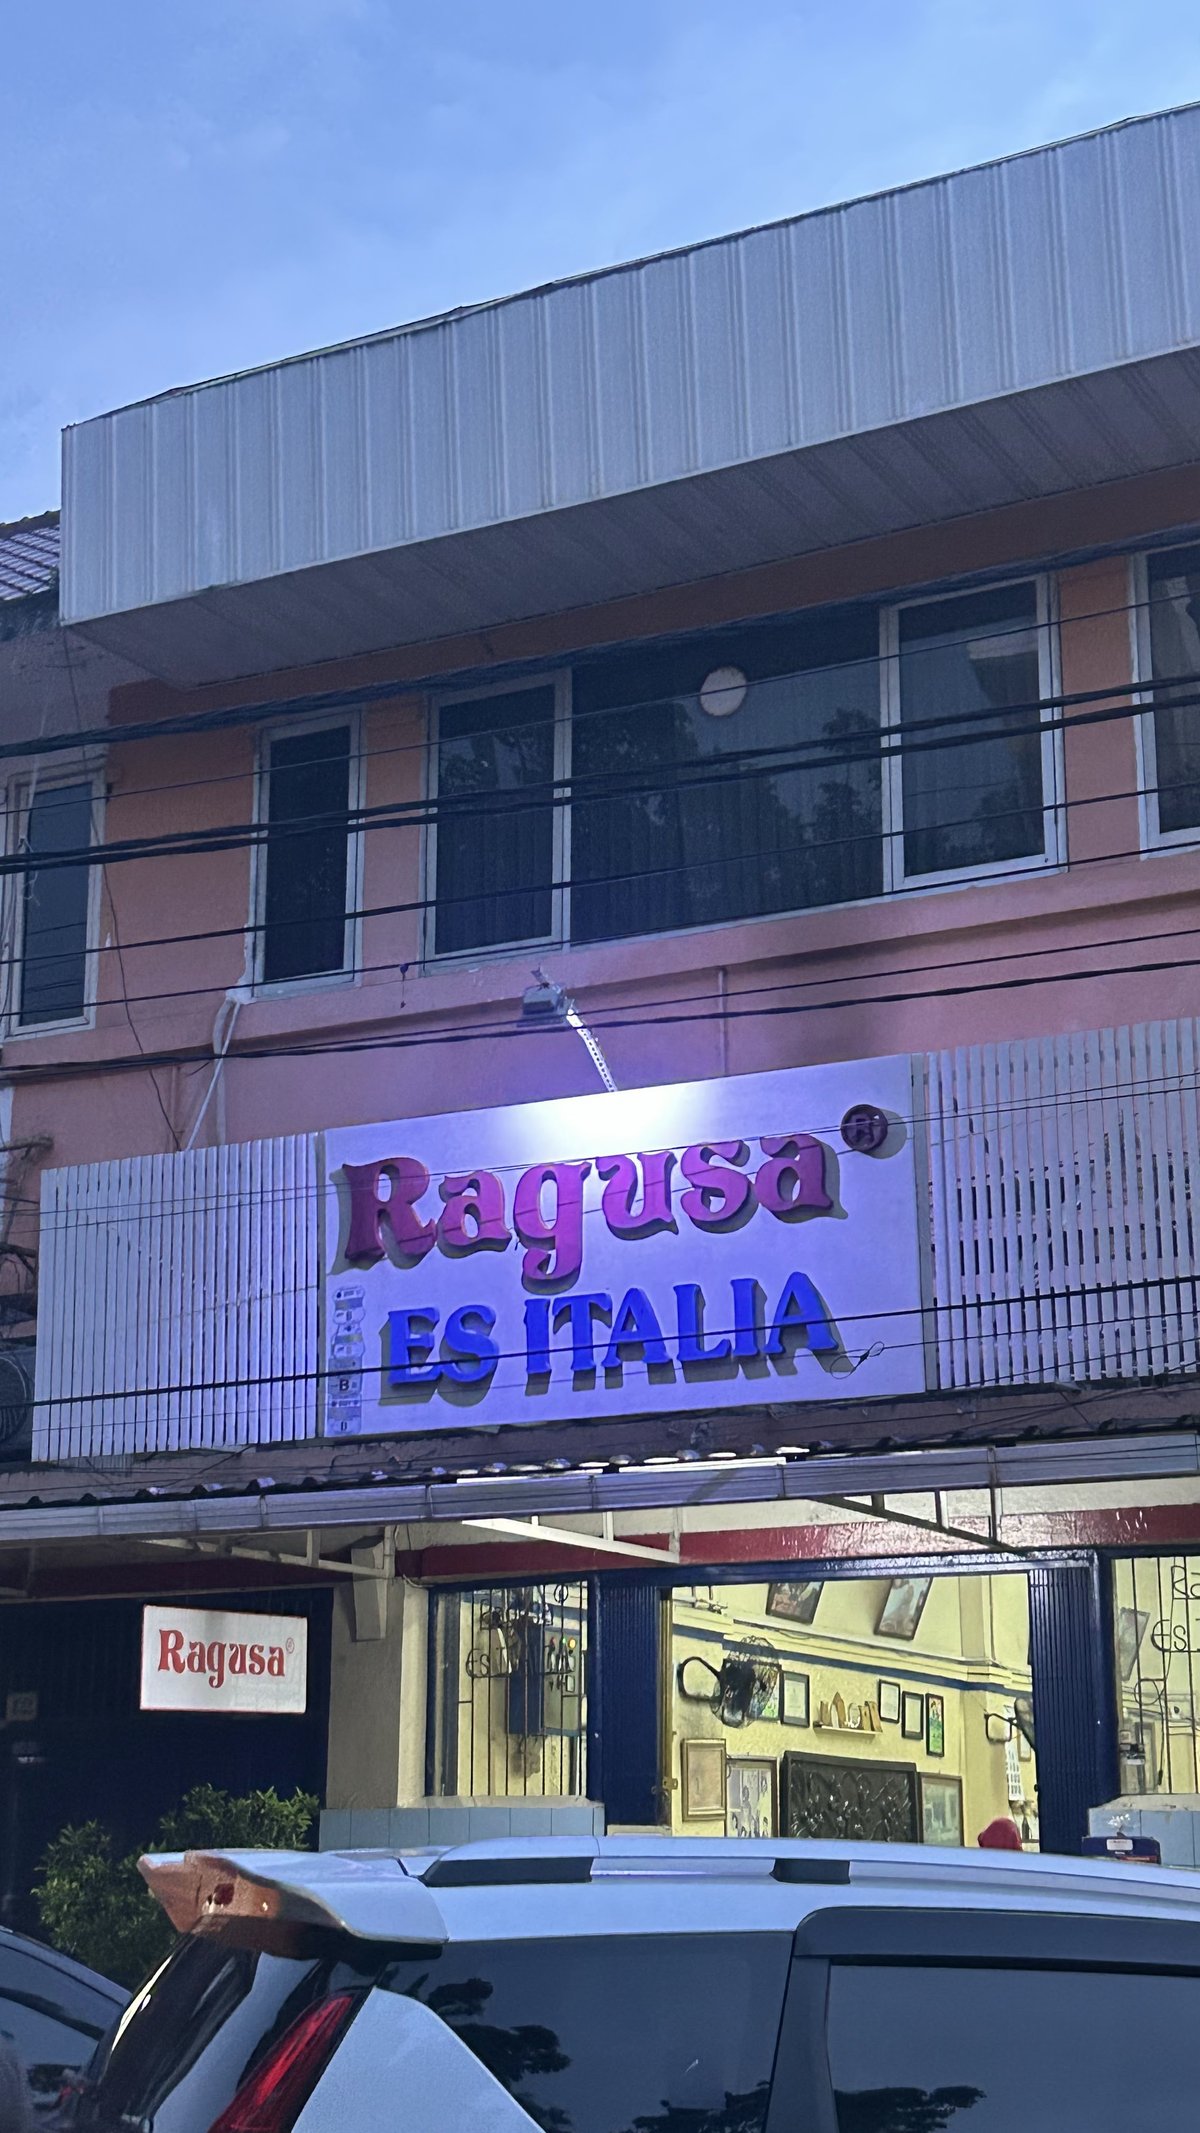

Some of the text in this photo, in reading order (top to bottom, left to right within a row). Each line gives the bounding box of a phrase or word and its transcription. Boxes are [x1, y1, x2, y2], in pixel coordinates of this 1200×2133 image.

[342, 1133, 836, 1294] Ragusa
[388, 1271, 839, 1386] ES ITALIA
[158, 1629, 285, 1688] Ragusa
